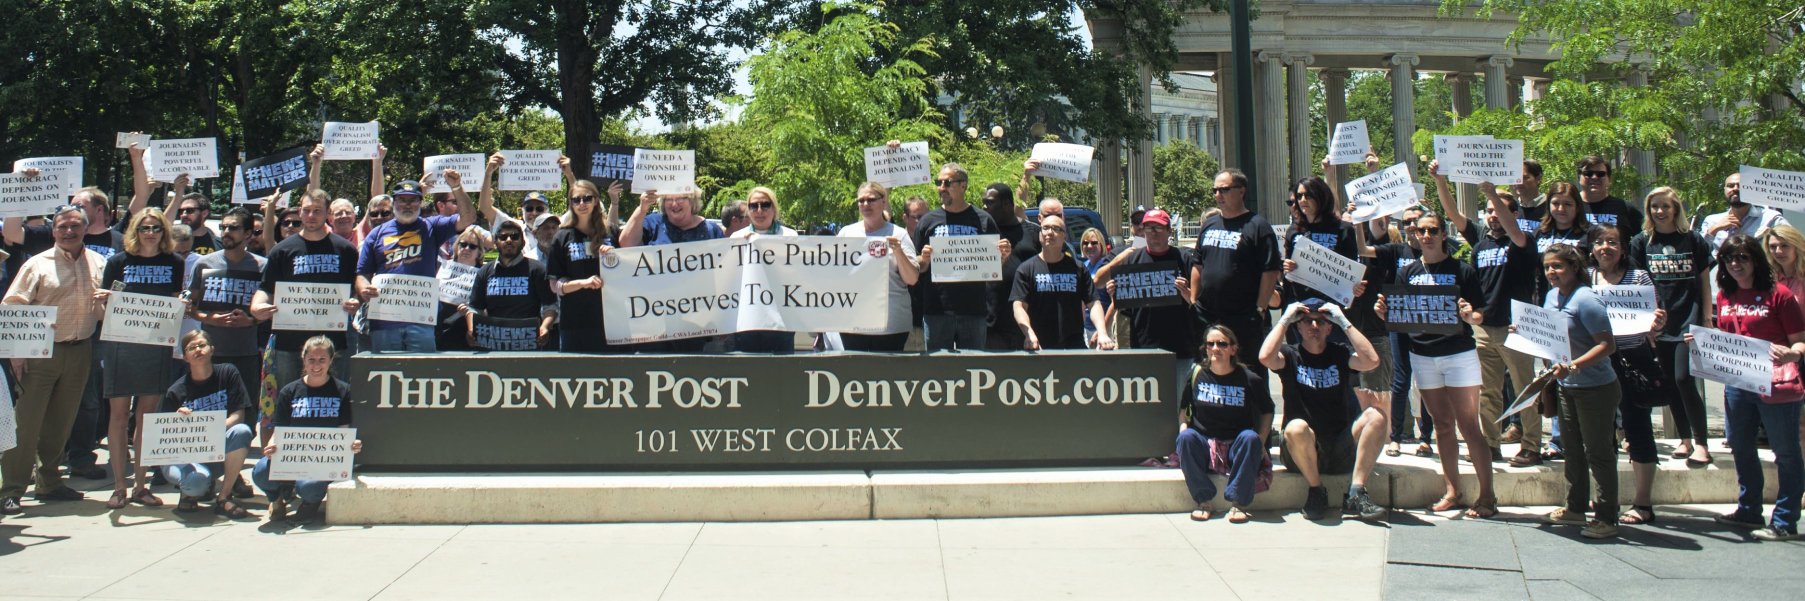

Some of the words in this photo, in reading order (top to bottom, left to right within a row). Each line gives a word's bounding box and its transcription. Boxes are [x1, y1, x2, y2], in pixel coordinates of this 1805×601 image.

[872, 146, 918, 156] DEMOCRACY
[592, 152, 634, 168] #NE
[874, 158, 906, 166] DEPENDS
[246, 155, 304, 180] #NEWS
[591, 166, 634, 180] MATTE
[874, 164, 922, 175] JOURNALISM
[2, 174, 59, 184] DEMOCRACY
[248, 167, 306, 191] MATTERS
[1369, 173, 1390, 182] NEED
[1762, 172, 1804, 182] QUALITY
[1353, 177, 1405, 200] RESPONSIBLE
[1753, 180, 1804, 190] JOURNALIS
[2, 194, 60, 203] JOURNALISM
[1367, 192, 1397, 206] OWNER
[935, 224, 978, 234] #NEWS
[1205, 230, 1242, 240] #NEWS
[1202, 238, 1238, 250] MATTERS
[293, 254, 339, 264] #NEWS
[386, 245, 422, 264] SEIU
[632, 248, 722, 277] Alden:
[731, 242, 776, 266] The
[784, 243, 862, 266] Public
[1308, 244, 1322, 256] WE
[1324, 251, 1344, 266] NEED
[124, 265, 174, 276] #NEWS
[294, 264, 340, 275] MATTERS
[1300, 251, 1356, 282] RESPONSIBLE
[1650, 265, 1692, 273] GUILD
[124, 276, 172, 284] MATTERS
[488, 276, 528, 286] #NEWS
[1036, 274, 1077, 283] #NEWS
[1115, 270, 1176, 288] #NEWS
[1308, 266, 1340, 286] OWNER
[205, 276, 261, 294] #NEW
[380, 278, 432, 288] DEMOCRACY
[1037, 282, 1076, 292] MATTERS
[380, 288, 418, 297] DEPENDS
[487, 286, 528, 296] MATTERS
[1116, 284, 1177, 300] MATTERS
[1609, 290, 1634, 298] NEED
[122, 297, 137, 305] WE
[140, 298, 164, 307] NEED
[202, 290, 252, 305] MATTE
[378, 298, 431, 308] JOURNALISM
[629, 292, 740, 319] Deserves
[745, 283, 774, 306] To
[782, 284, 860, 308] Know
[1387, 294, 1456, 310] #NEWS
[1604, 301, 1651, 310] PONSIBLE
[0, 310, 48, 318] MOCRACY
[113, 307, 178, 320] RESPONSIBLE
[1388, 310, 1458, 324] MATTERS
[1525, 308, 1549, 320] QUALITY
[125, 320, 160, 330] OWNER
[1520, 316, 1556, 330] JOURNALISM
[476, 324, 537, 340] #NEWS
[1532, 327, 1567, 344] CORPORATE
[476, 337, 538, 350] MATTERS
[1530, 337, 1552, 348] GREED
[1711, 334, 1748, 347] QUALITY
[1701, 342, 1757, 360] JOURNALISM
[1692, 349, 1714, 360] OVER
[1716, 356, 1768, 373] CORPORATE
[1297, 364, 1340, 380] #NEWS
[1714, 364, 1742, 376] GREED
[804, 368, 1162, 408] DenverPost.com
[1297, 375, 1340, 389] MATTERS
[368, 371, 456, 408] THE
[465, 371, 637, 408] DENVER
[646, 371, 748, 408] POST
[1198, 382, 1246, 397] #NEWS
[292, 397, 340, 408] #NEWS
[1198, 394, 1244, 407] MATTERS
[292, 408, 340, 418] MATTERS
[155, 416, 214, 424] JOURNALISTS
[160, 436, 209, 444] POWERFUL
[284, 432, 348, 440] DEMOCRACY
[635, 430, 678, 452] 101
[690, 428, 776, 452] WEST
[786, 428, 903, 452] COLFAX
[150, 446, 216, 456] ACCOUNTABLE
[280, 455, 344, 464] JOURNALISM
